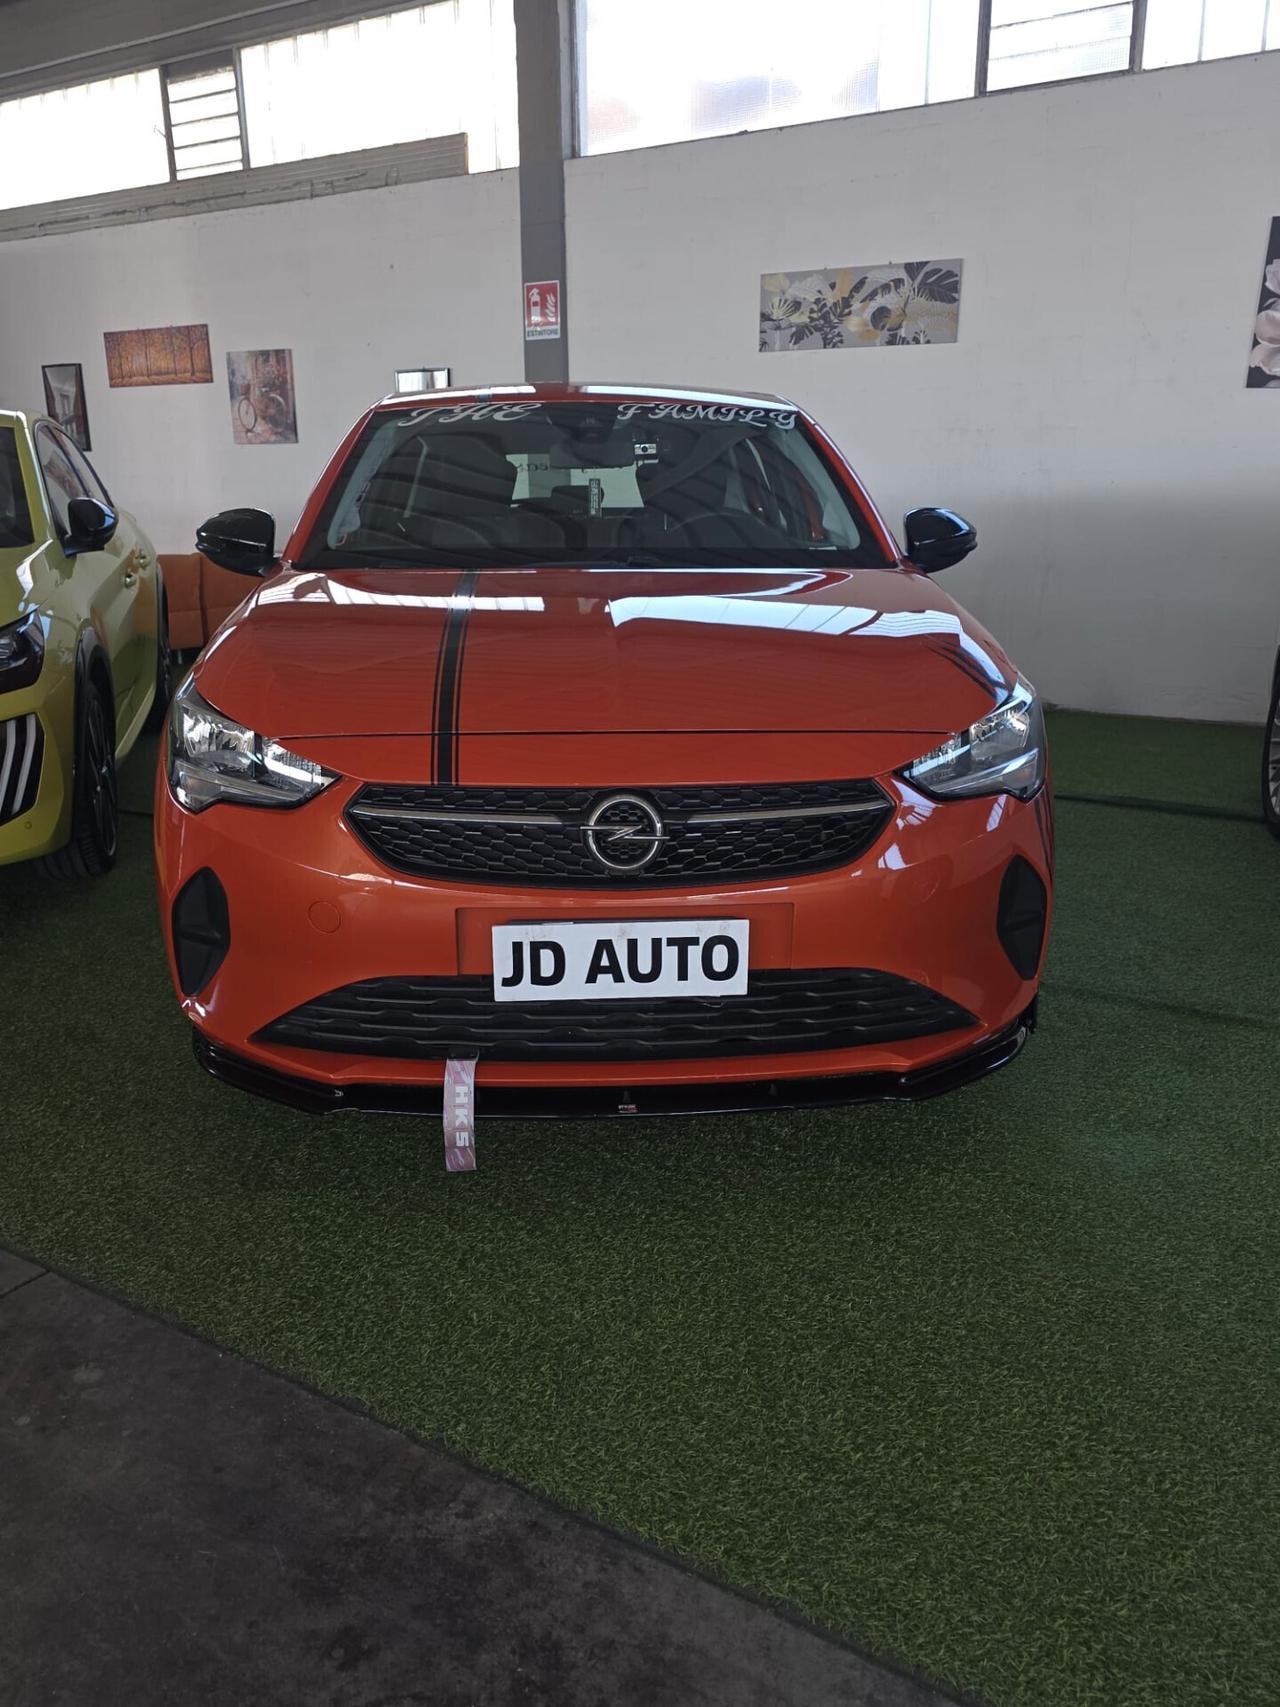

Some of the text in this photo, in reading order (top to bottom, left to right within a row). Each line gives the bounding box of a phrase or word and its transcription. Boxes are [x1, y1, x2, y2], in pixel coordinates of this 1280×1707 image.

[527, 329, 559, 337] ESTINTORE
[398, 402, 797, 430] THE FAMILY
[501, 934, 739, 987] JD AUTO
[455, 1086, 469, 1147] HKS
